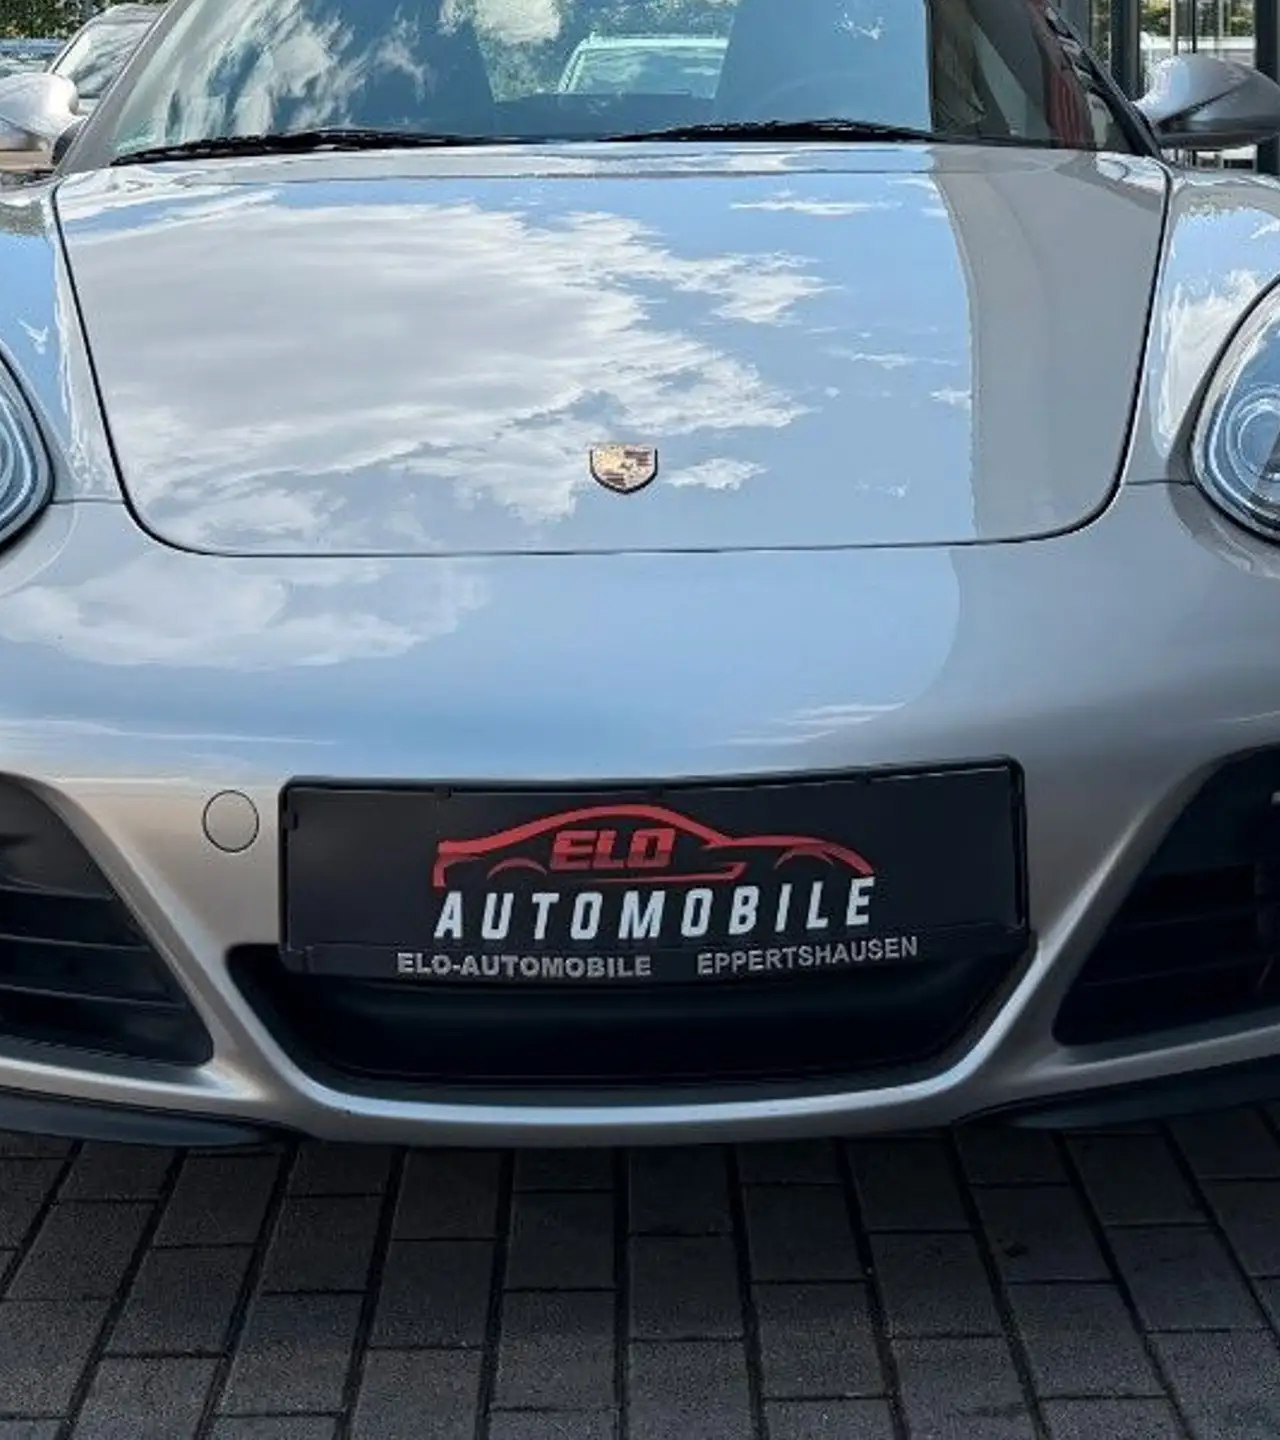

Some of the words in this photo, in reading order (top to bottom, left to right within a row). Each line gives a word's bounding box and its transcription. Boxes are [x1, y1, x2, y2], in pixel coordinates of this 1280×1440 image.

[550, 828, 676, 871] ELO
[434, 876, 877, 941] AUTOMOBILE
[396, 951, 652, 978] ELO-AUTOMOBILE
[697, 936, 919, 976] EPPERTSHAUSEN
